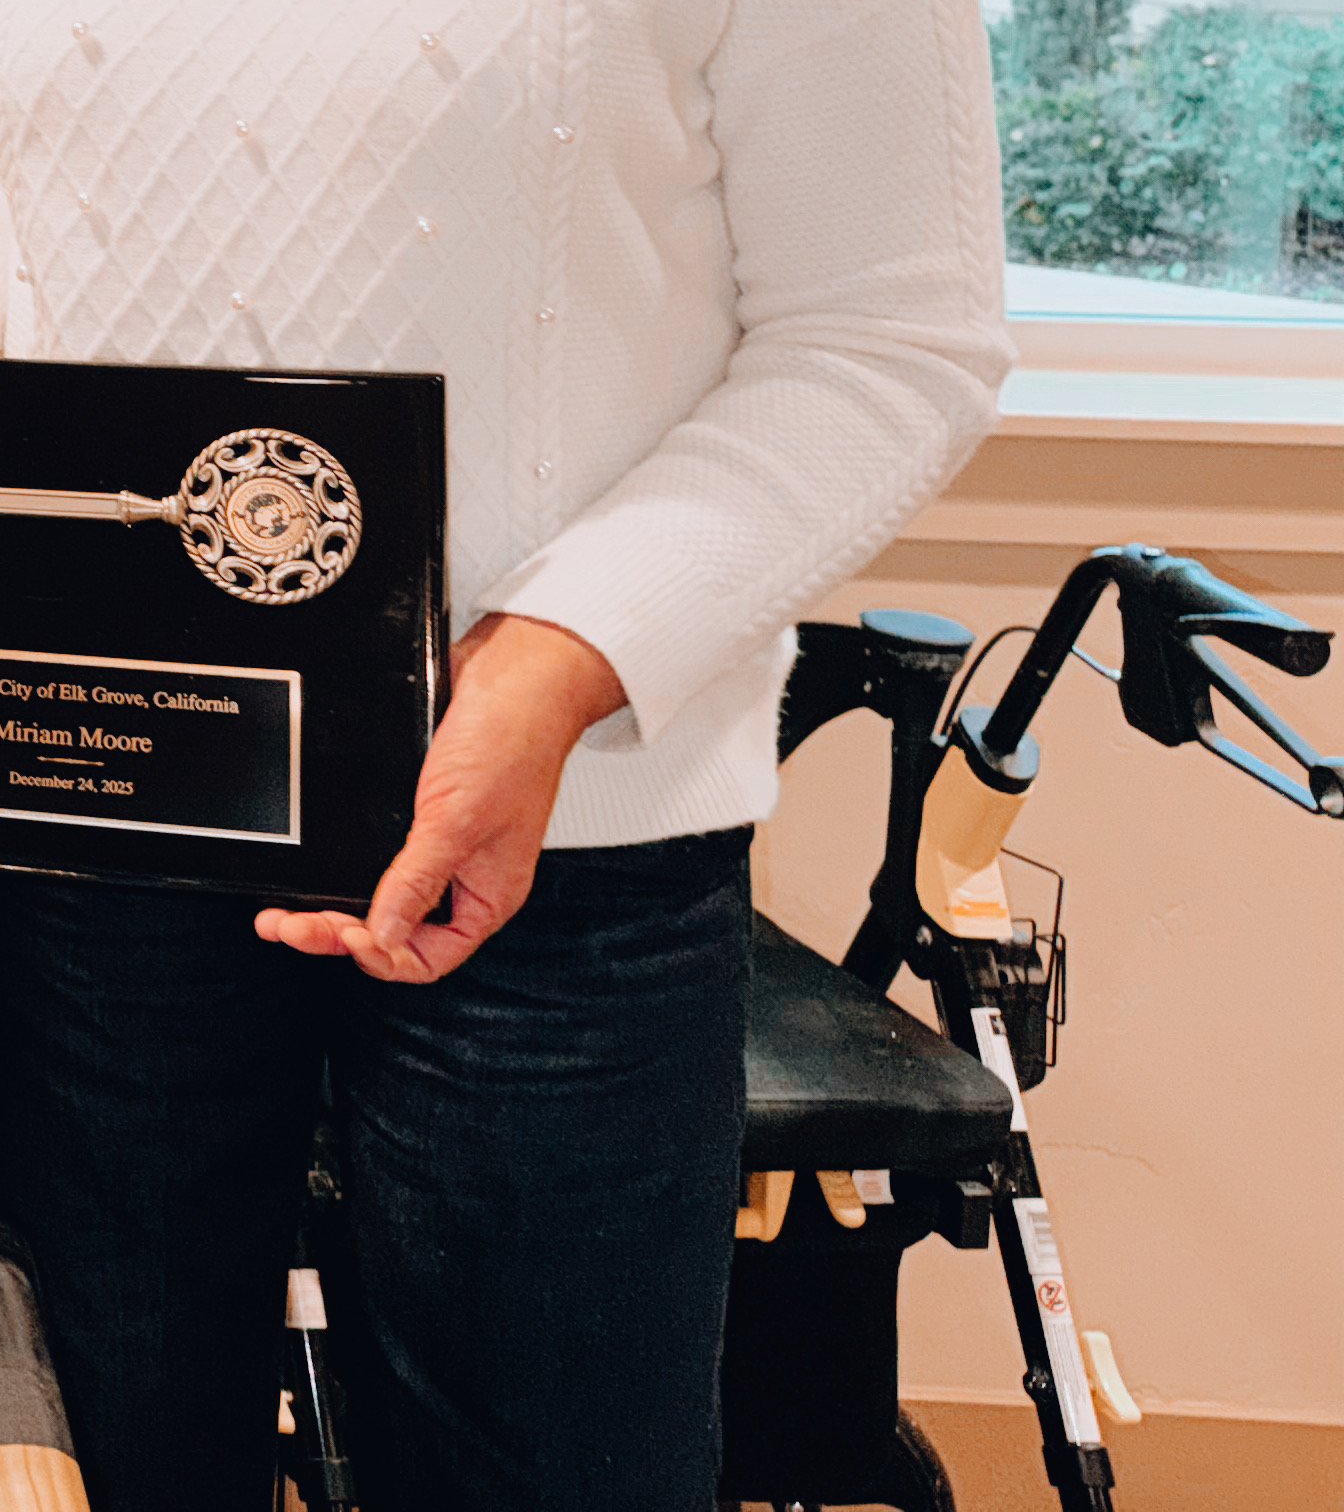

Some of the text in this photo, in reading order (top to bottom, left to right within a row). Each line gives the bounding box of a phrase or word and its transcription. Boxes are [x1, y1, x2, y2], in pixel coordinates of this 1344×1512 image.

[36, 681, 56, 699] of
[58, 682, 88, 702] Elk
[91, 686, 151, 709] Grove,
[152, 690, 240, 714] California
[78, 726, 153, 753] Moore
[9, 771, 74, 791] December
[101, 777, 134, 795] 2025
